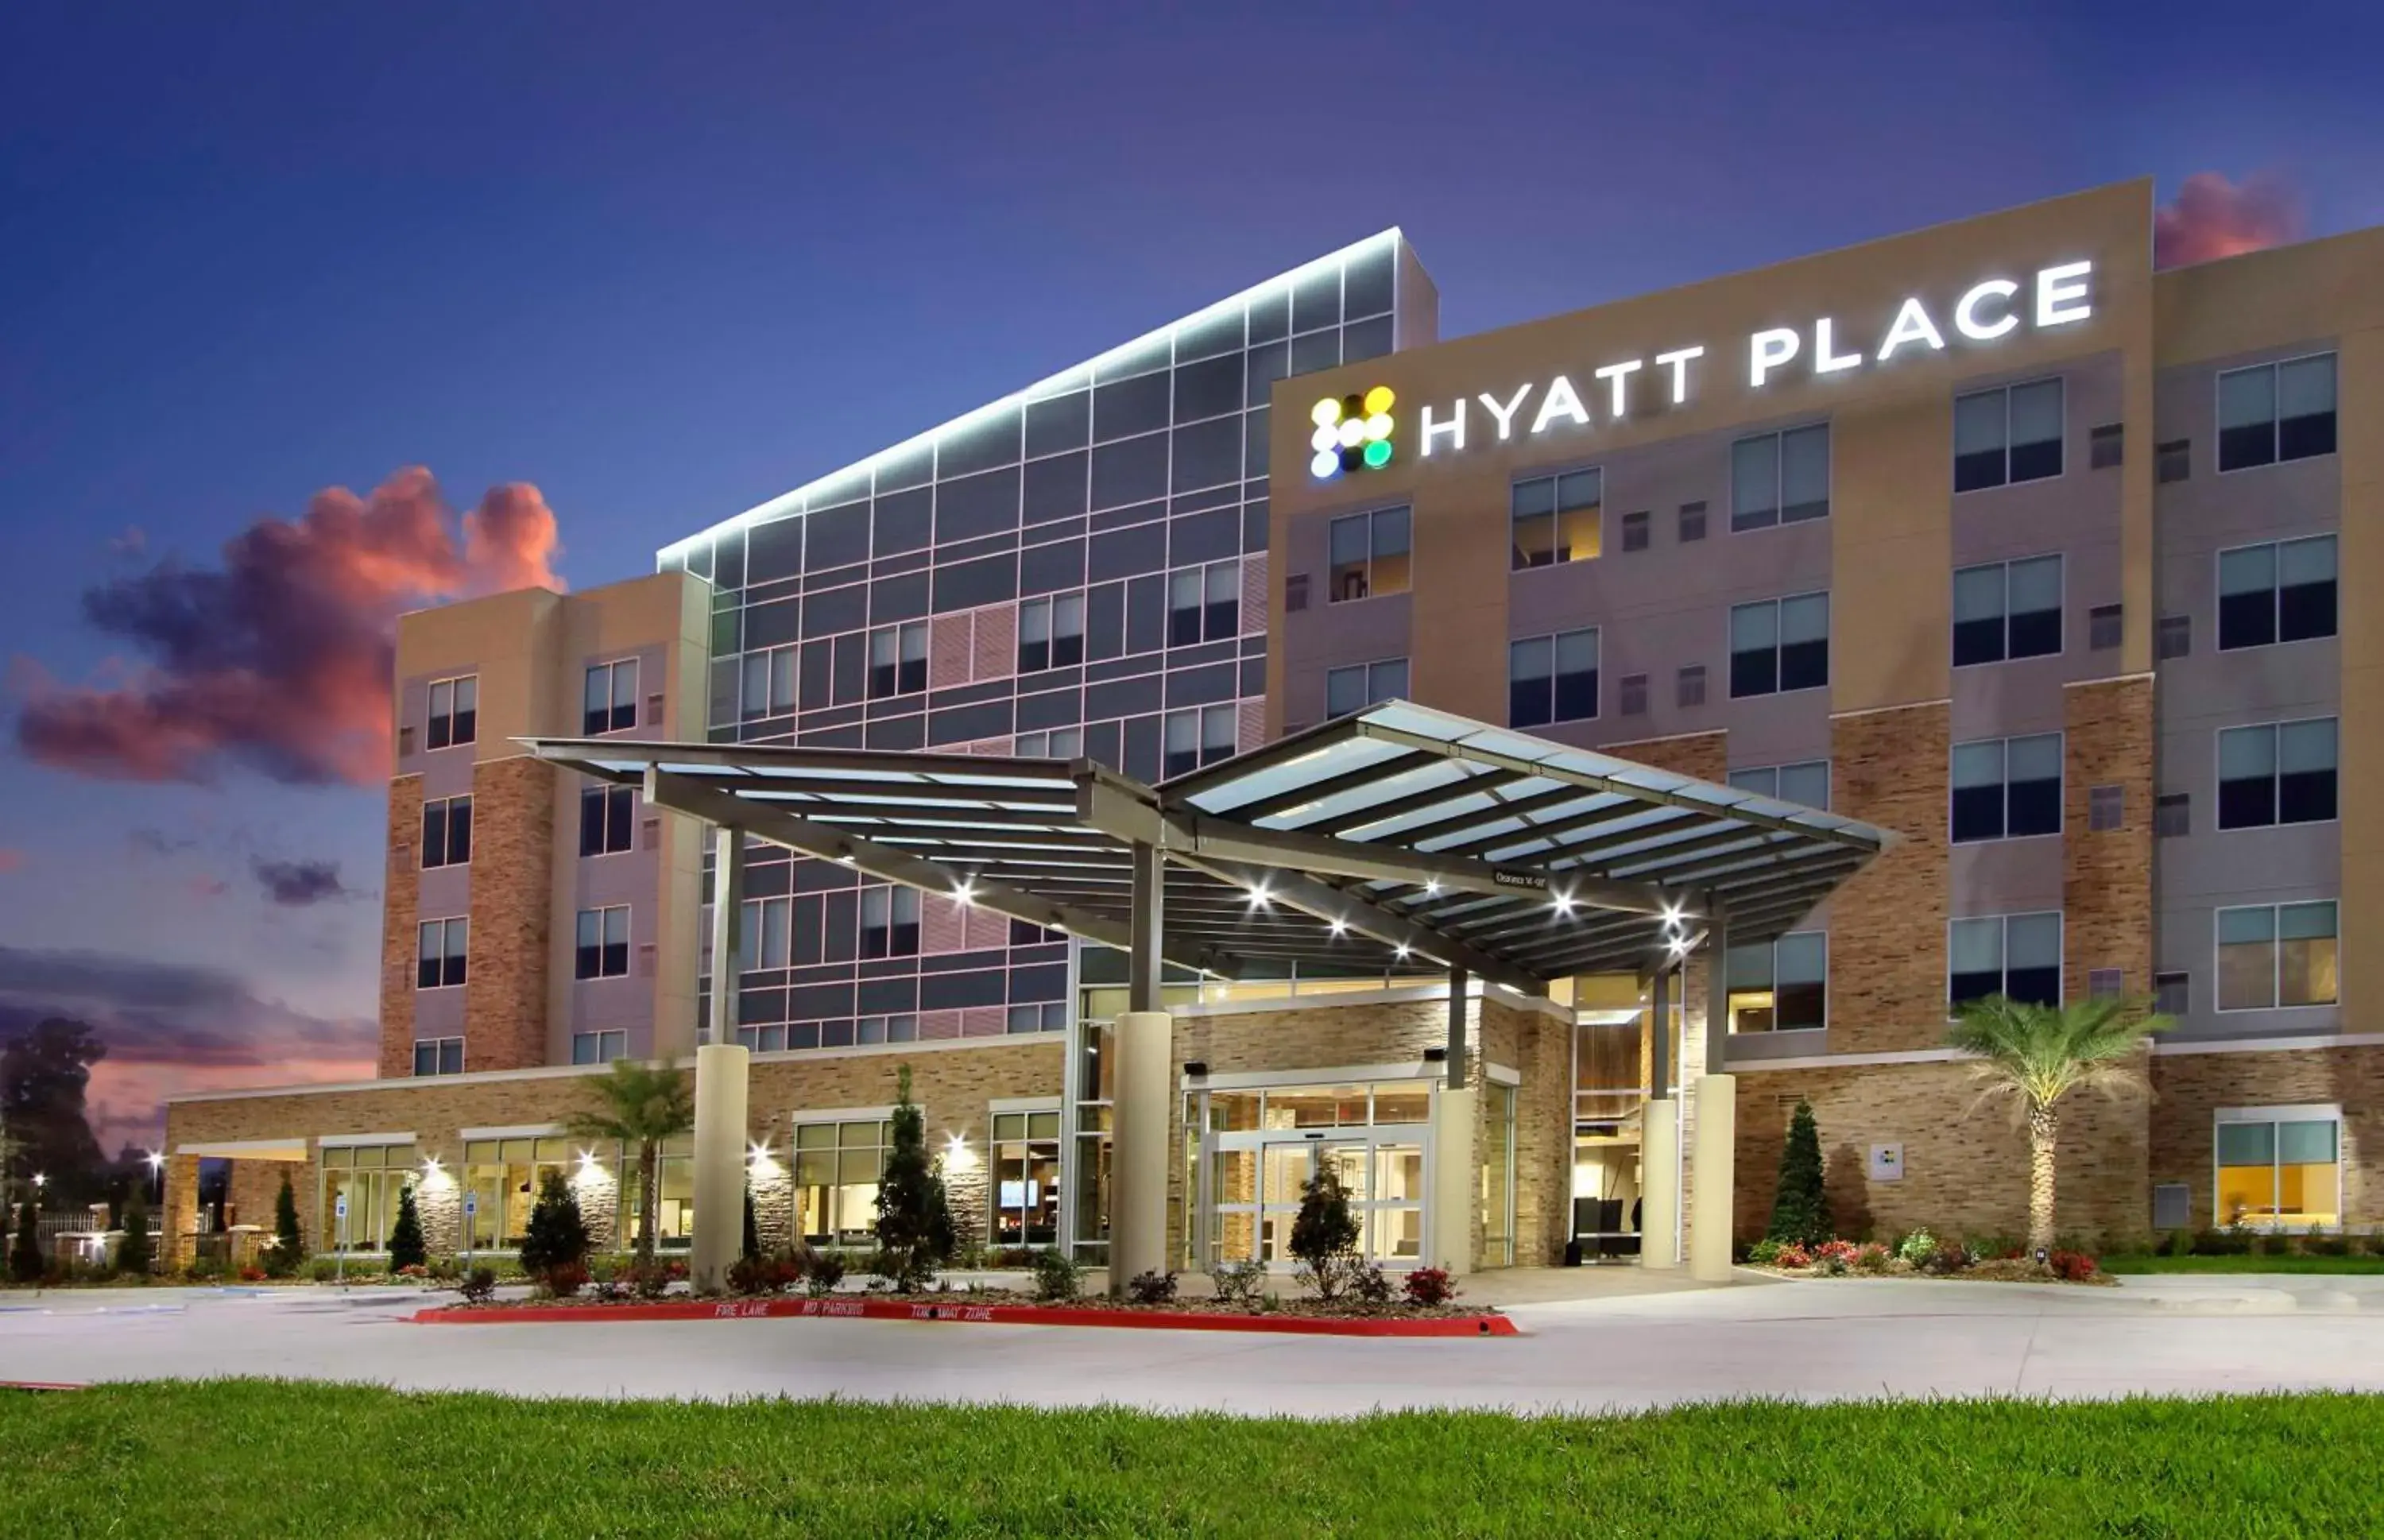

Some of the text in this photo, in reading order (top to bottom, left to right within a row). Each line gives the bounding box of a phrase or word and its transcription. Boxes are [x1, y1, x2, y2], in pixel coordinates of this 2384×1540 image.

[1418, 259, 2092, 458] HYATT PLACE
[715, 1304, 769, 1317] FIRE LANE
[802, 1301, 864, 1315] NO PARKING
[964, 1306, 995, 1320] ZONE
